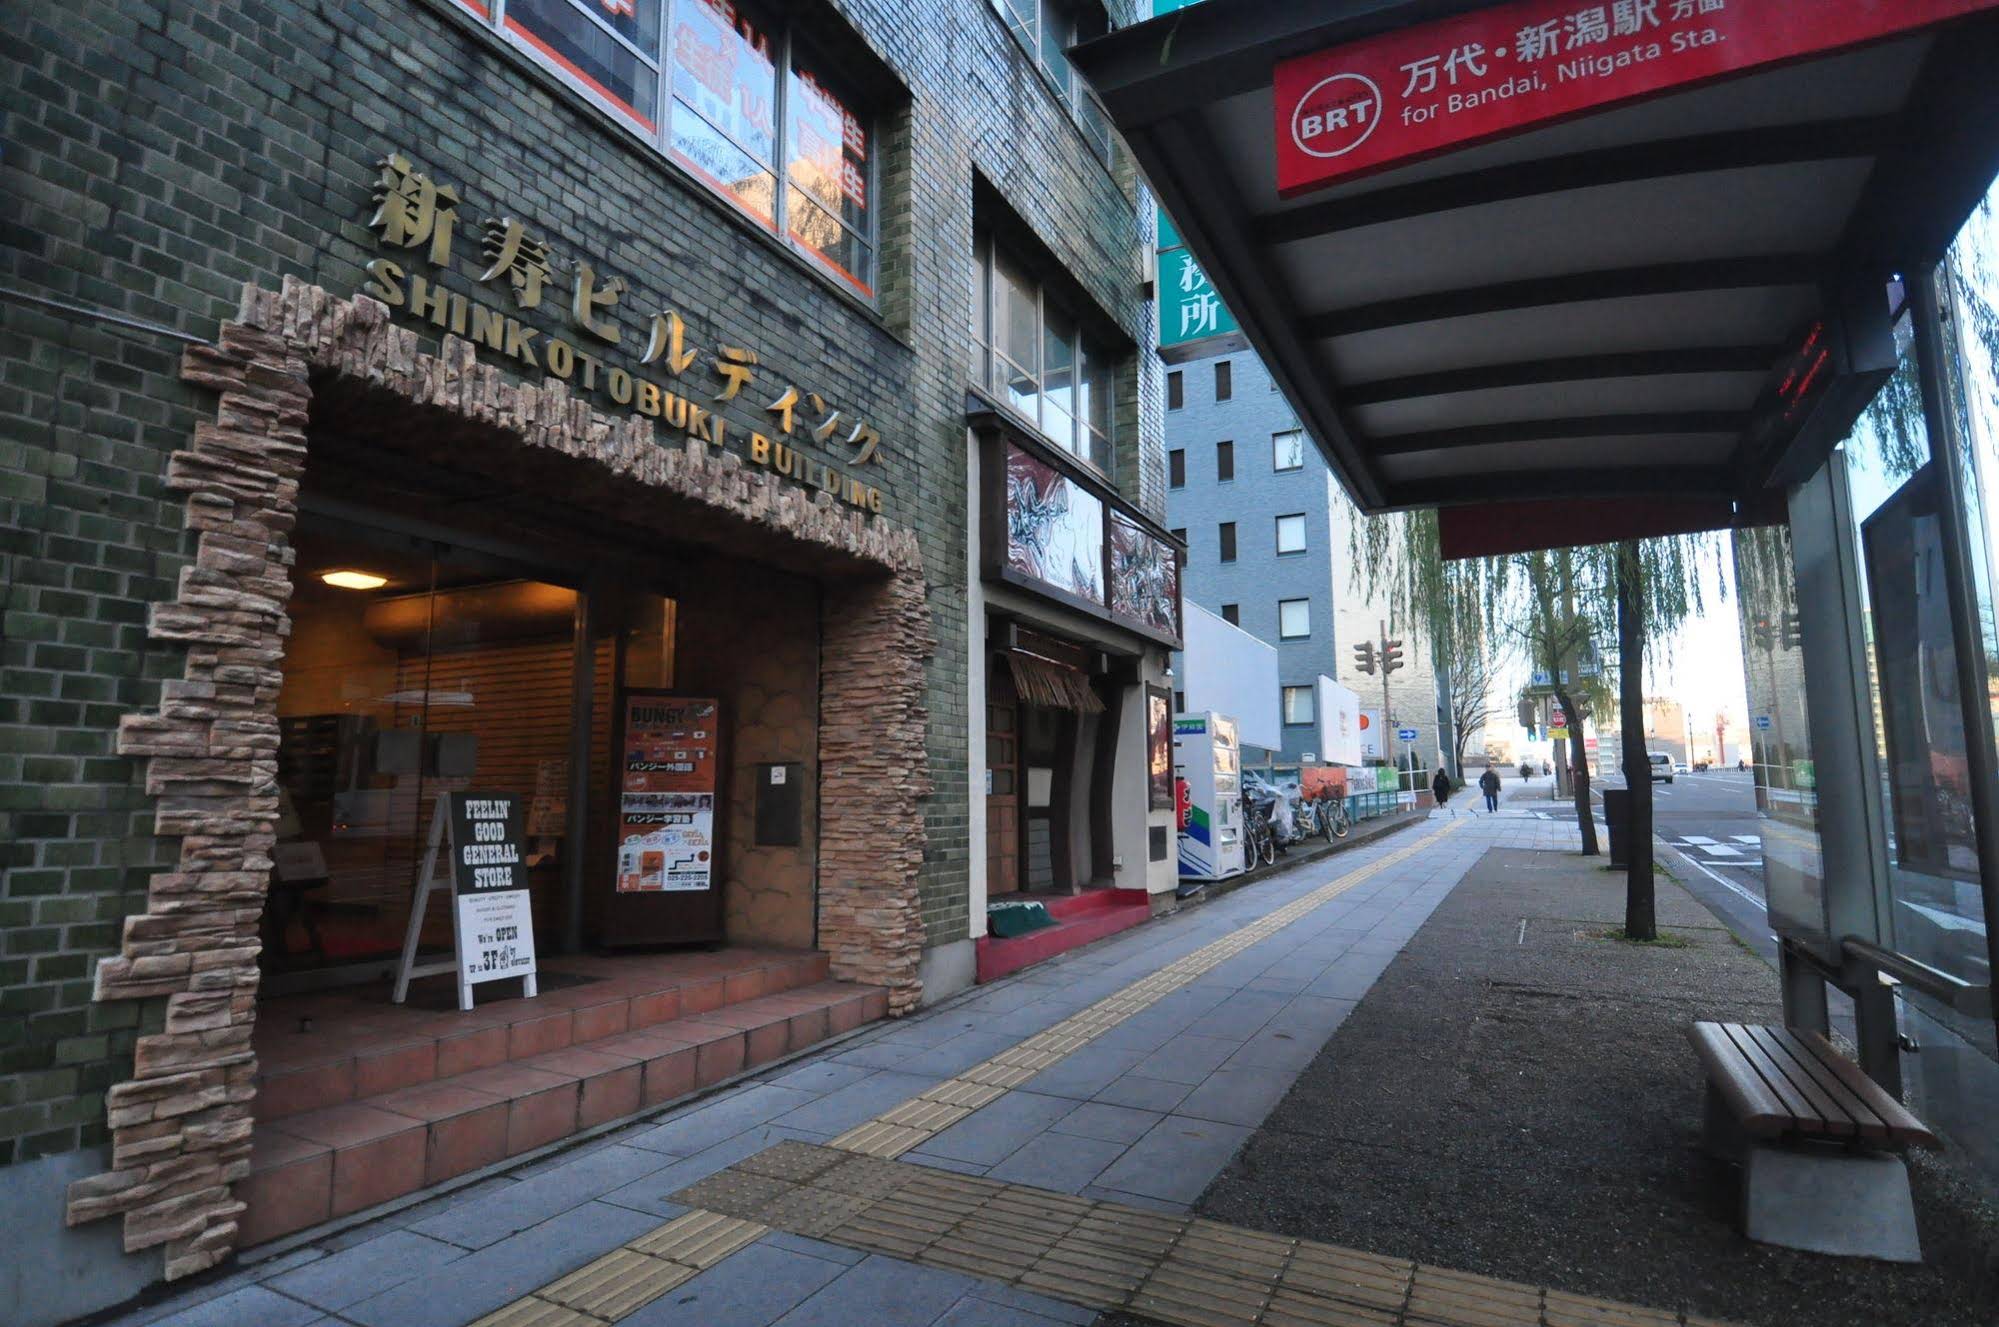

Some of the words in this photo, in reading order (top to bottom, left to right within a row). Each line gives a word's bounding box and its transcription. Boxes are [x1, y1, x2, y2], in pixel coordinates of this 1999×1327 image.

[1401, 103, 1440, 126] for
[1448, 70, 1547, 113] Bandai,
[1558, 42, 1661, 83] Niigata
[1670, 28, 1728, 53] Sta.
[1302, 99, 1373, 139] BRT
[367, 152, 884, 466] 新寿ビルディング
[363, 258, 725, 447] SHINKOTOBUKI
[750, 431, 883, 513] BUILDING
[465, 800, 511, 820] FEELIN'
[474, 822, 505, 842] GOOD
[463, 844, 519, 865] GENERAL
[474, 866, 513, 888] STORE
[496, 925, 518, 942] OPEN
